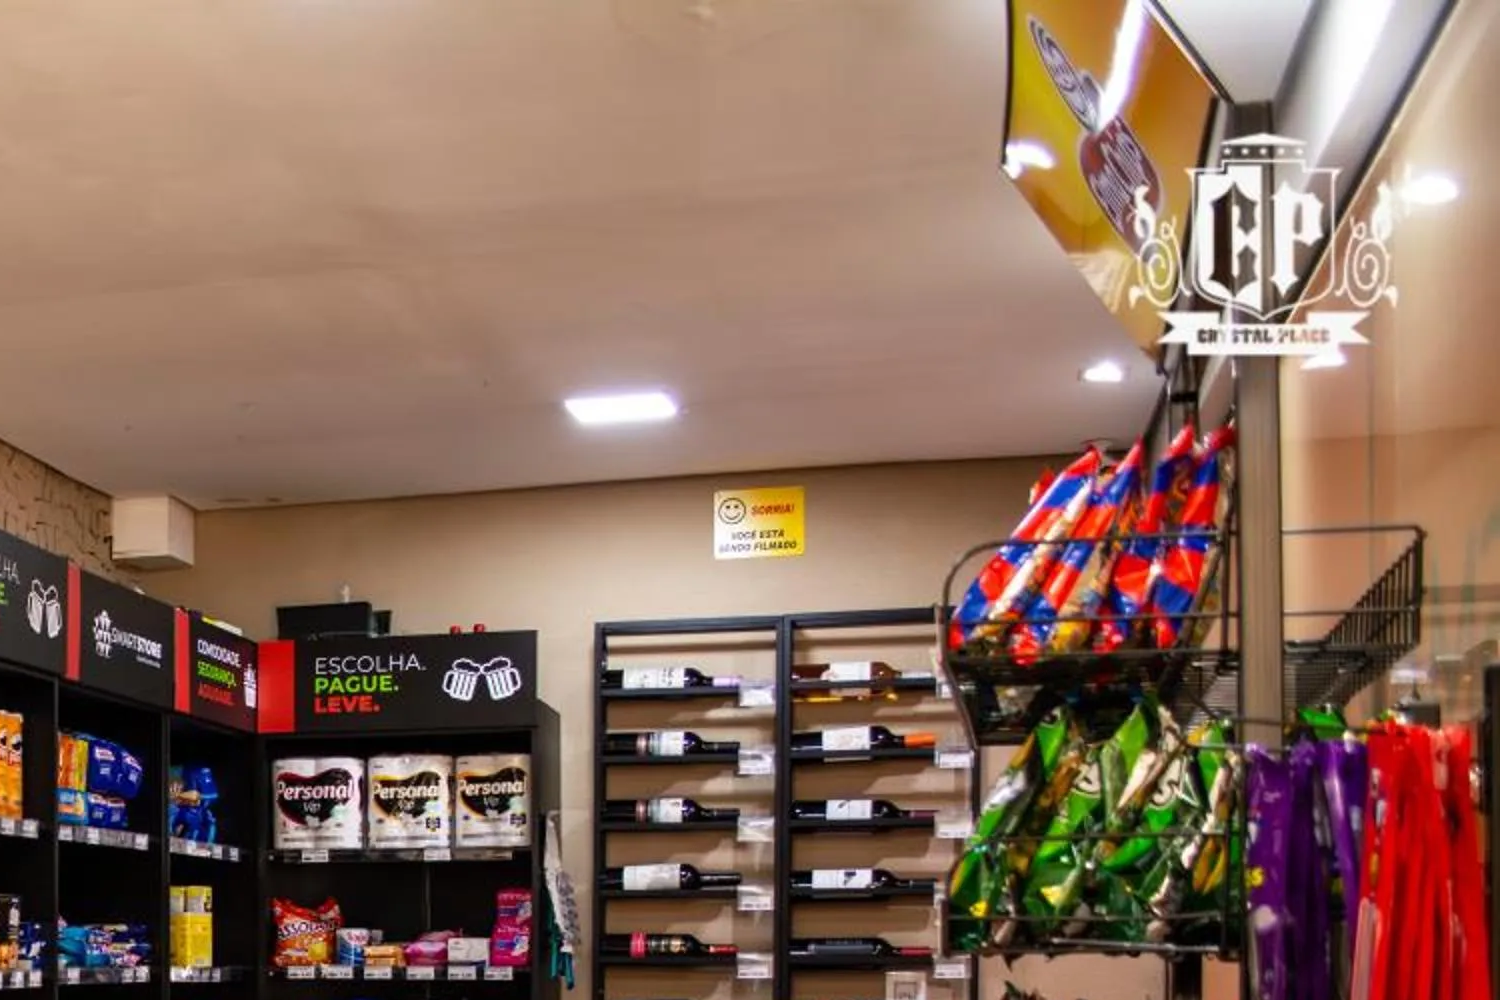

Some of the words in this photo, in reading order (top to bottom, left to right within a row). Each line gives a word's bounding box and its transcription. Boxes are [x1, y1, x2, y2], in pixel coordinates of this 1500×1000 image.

[315, 653, 427, 675] ESCOLHA.
[315, 675, 399, 694] PAGUE.
[314, 695, 380, 713] LEVE.
[276, 779, 353, 801] Personal
[372, 780, 441, 801] Personal
[458, 776, 527, 797] Personal
